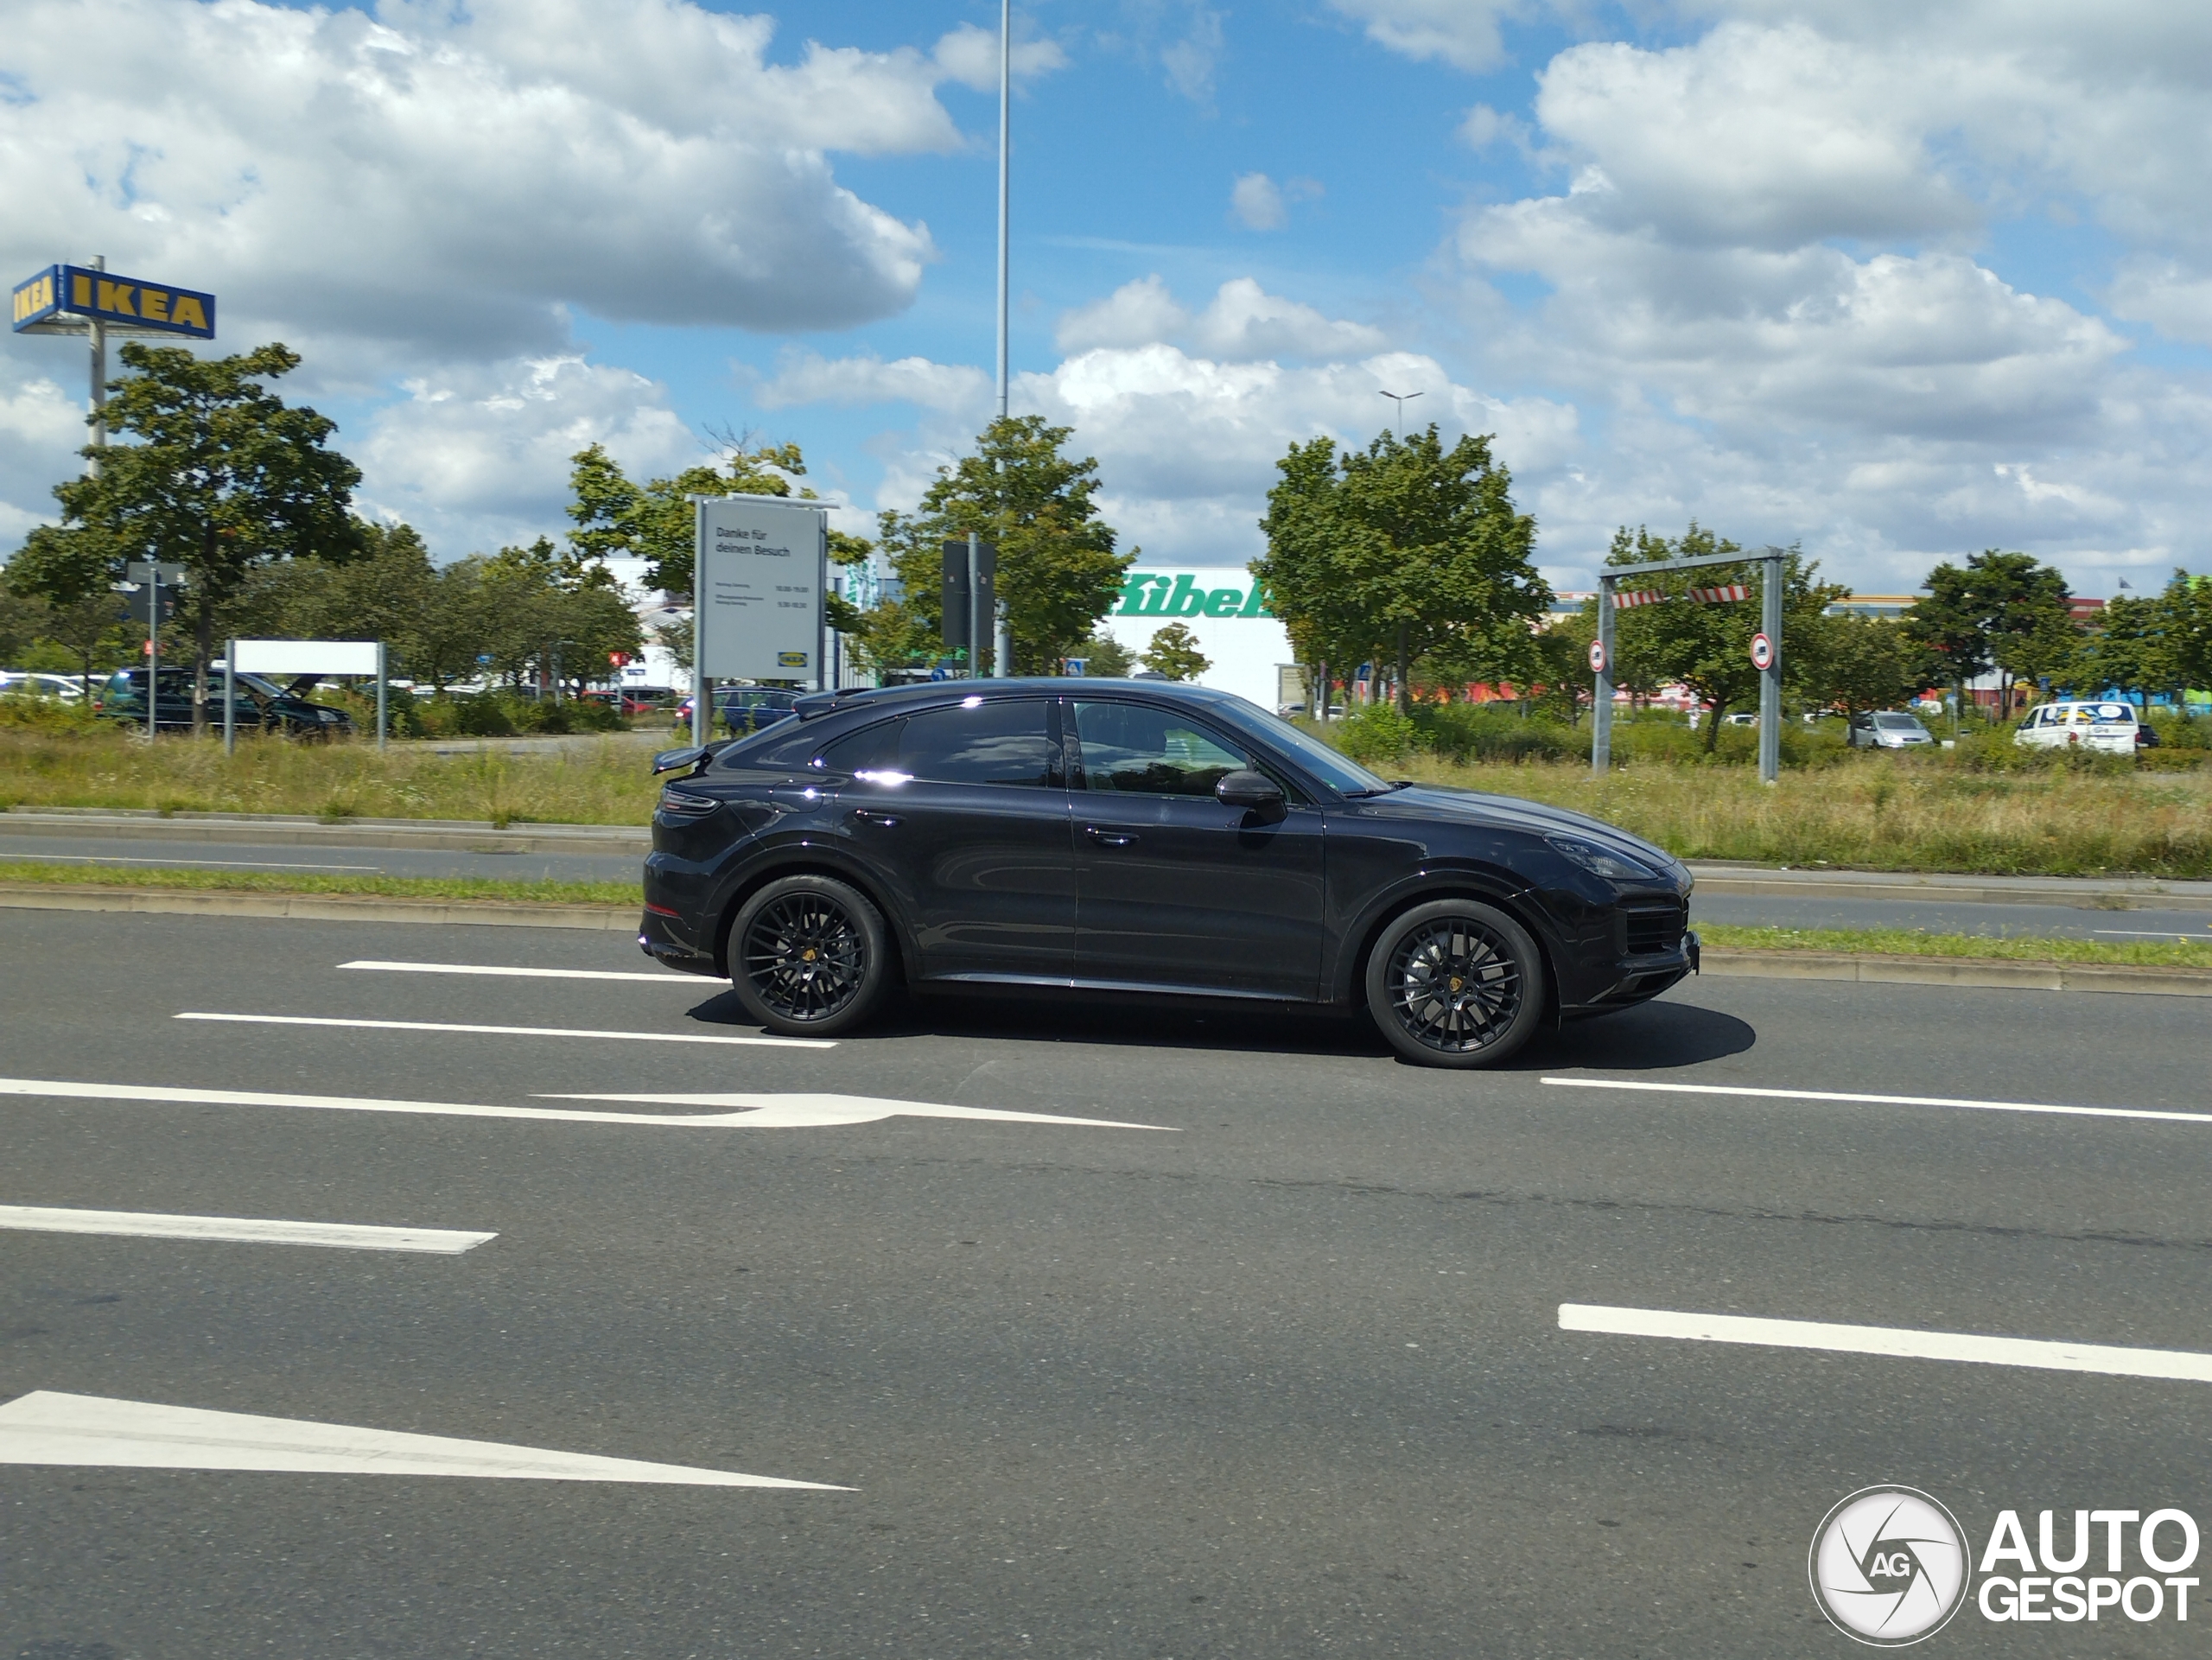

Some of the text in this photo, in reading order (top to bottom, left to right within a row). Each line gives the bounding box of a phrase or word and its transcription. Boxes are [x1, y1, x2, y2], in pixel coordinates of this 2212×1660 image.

[13, 276, 54, 323] IKEA
[73, 274, 209, 329] IKEA
[716, 526, 767, 541] Danke für
[715, 542, 791, 557] deinen Besuch
